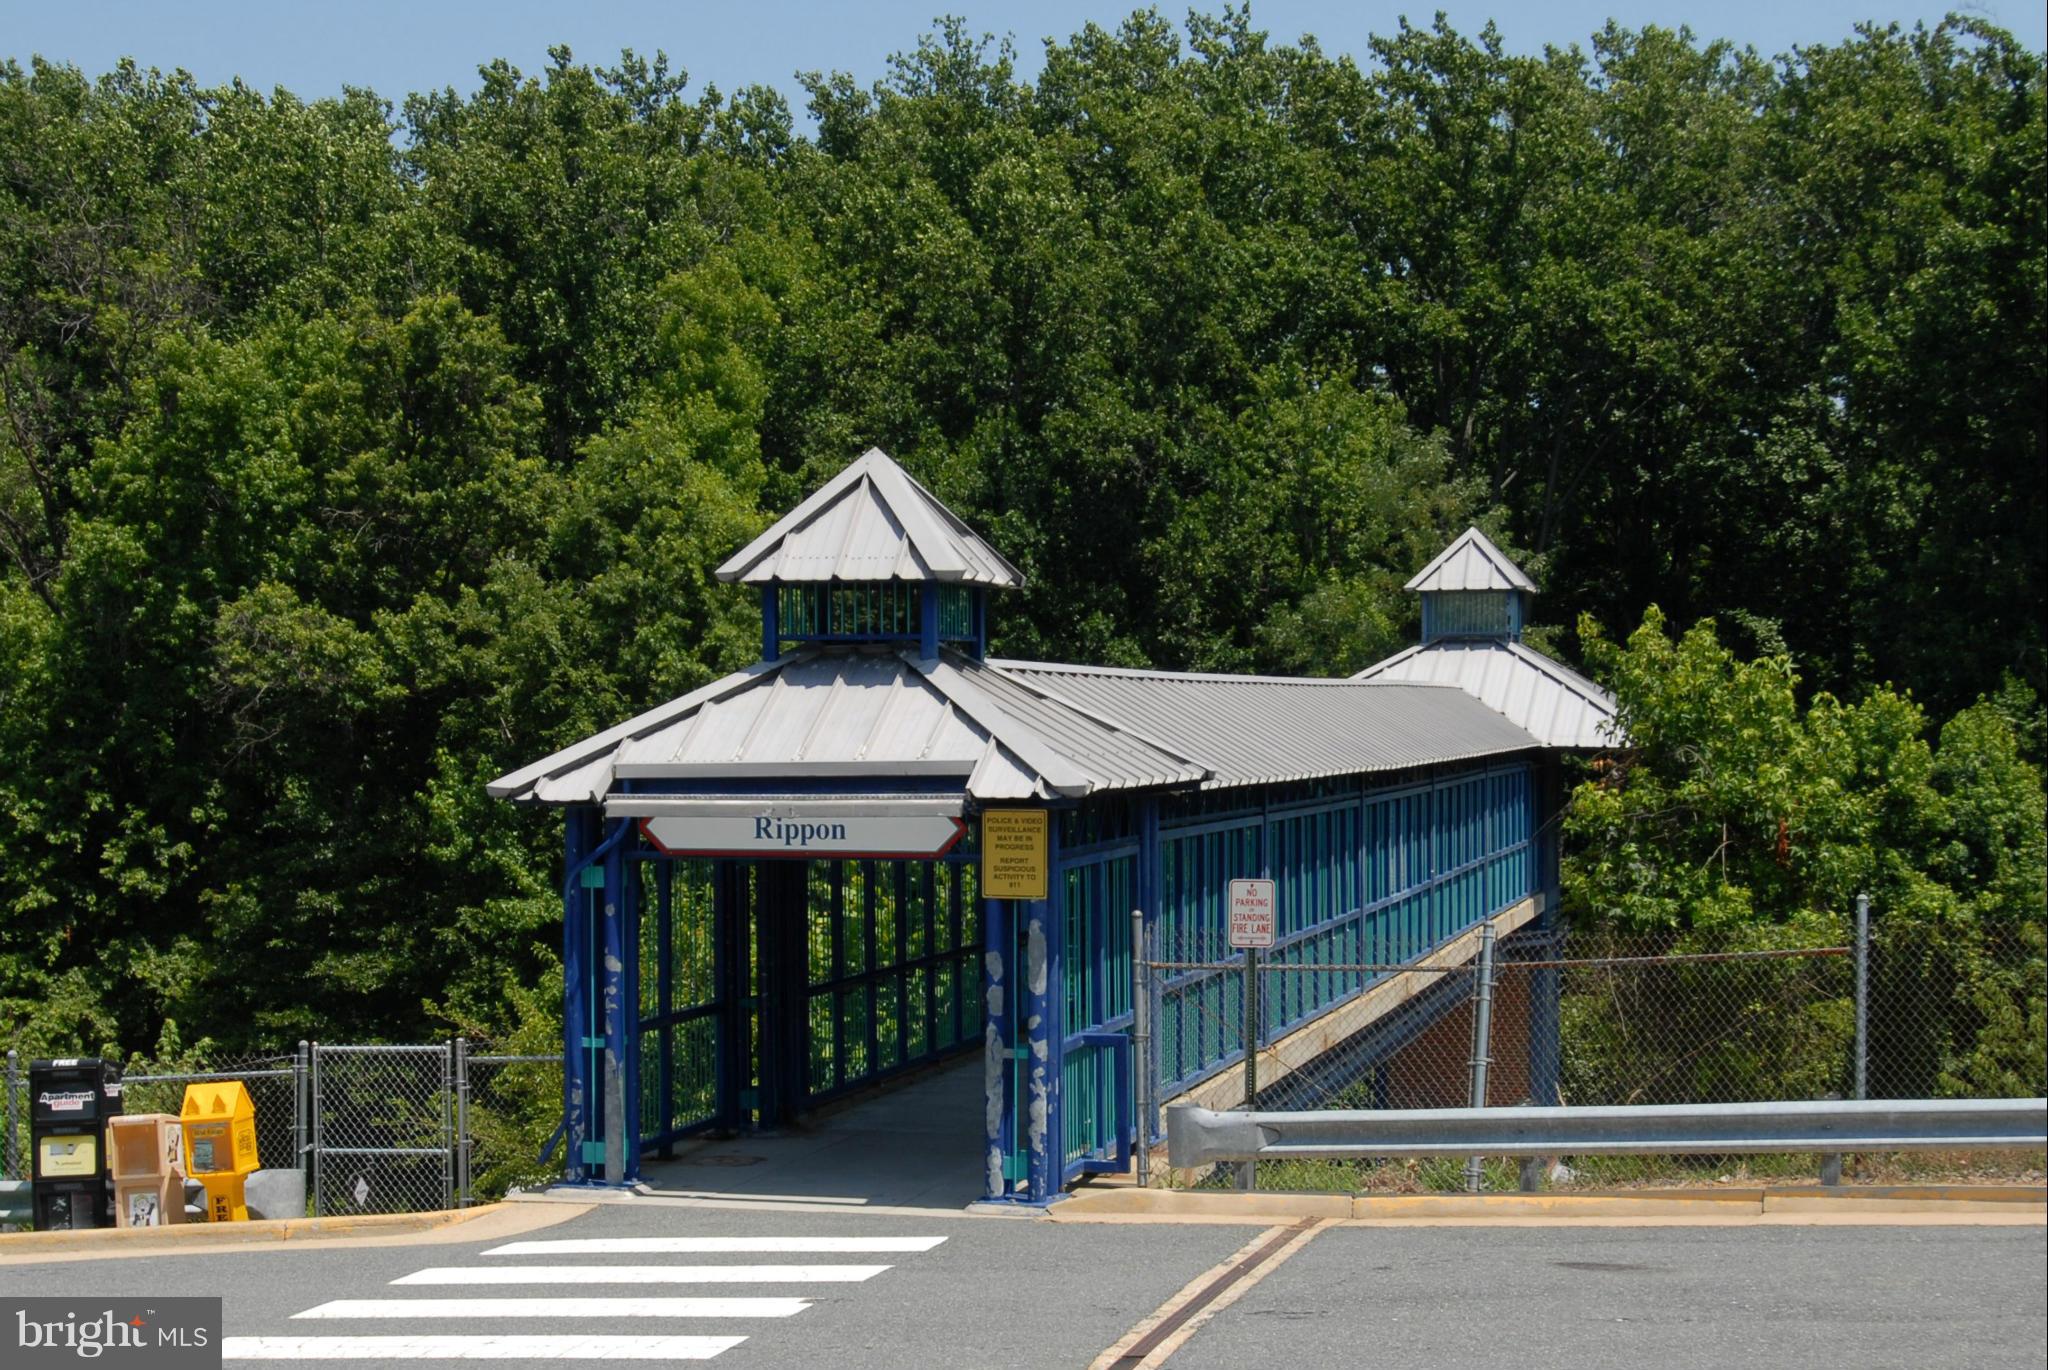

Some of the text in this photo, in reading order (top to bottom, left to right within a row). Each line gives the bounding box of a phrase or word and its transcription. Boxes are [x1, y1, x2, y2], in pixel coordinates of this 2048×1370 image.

[986, 817, 1011, 825] POLICE
[1022, 817, 1043, 825] VIDEO
[754, 816, 846, 846] Rippon
[994, 843, 1035, 851] PROGRESS
[1246, 888, 1258, 898] NO
[1235, 898, 1269, 908] PARKING
[1233, 913, 1271, 922] STANDING
[1232, 923, 1271, 934] FIRE LANE
[52, 1059, 79, 1068] FREE
[40, 1091, 95, 1103] Apartment
[53, 1100, 80, 1109] guide
[215, 1197, 229, 1222] FRE
